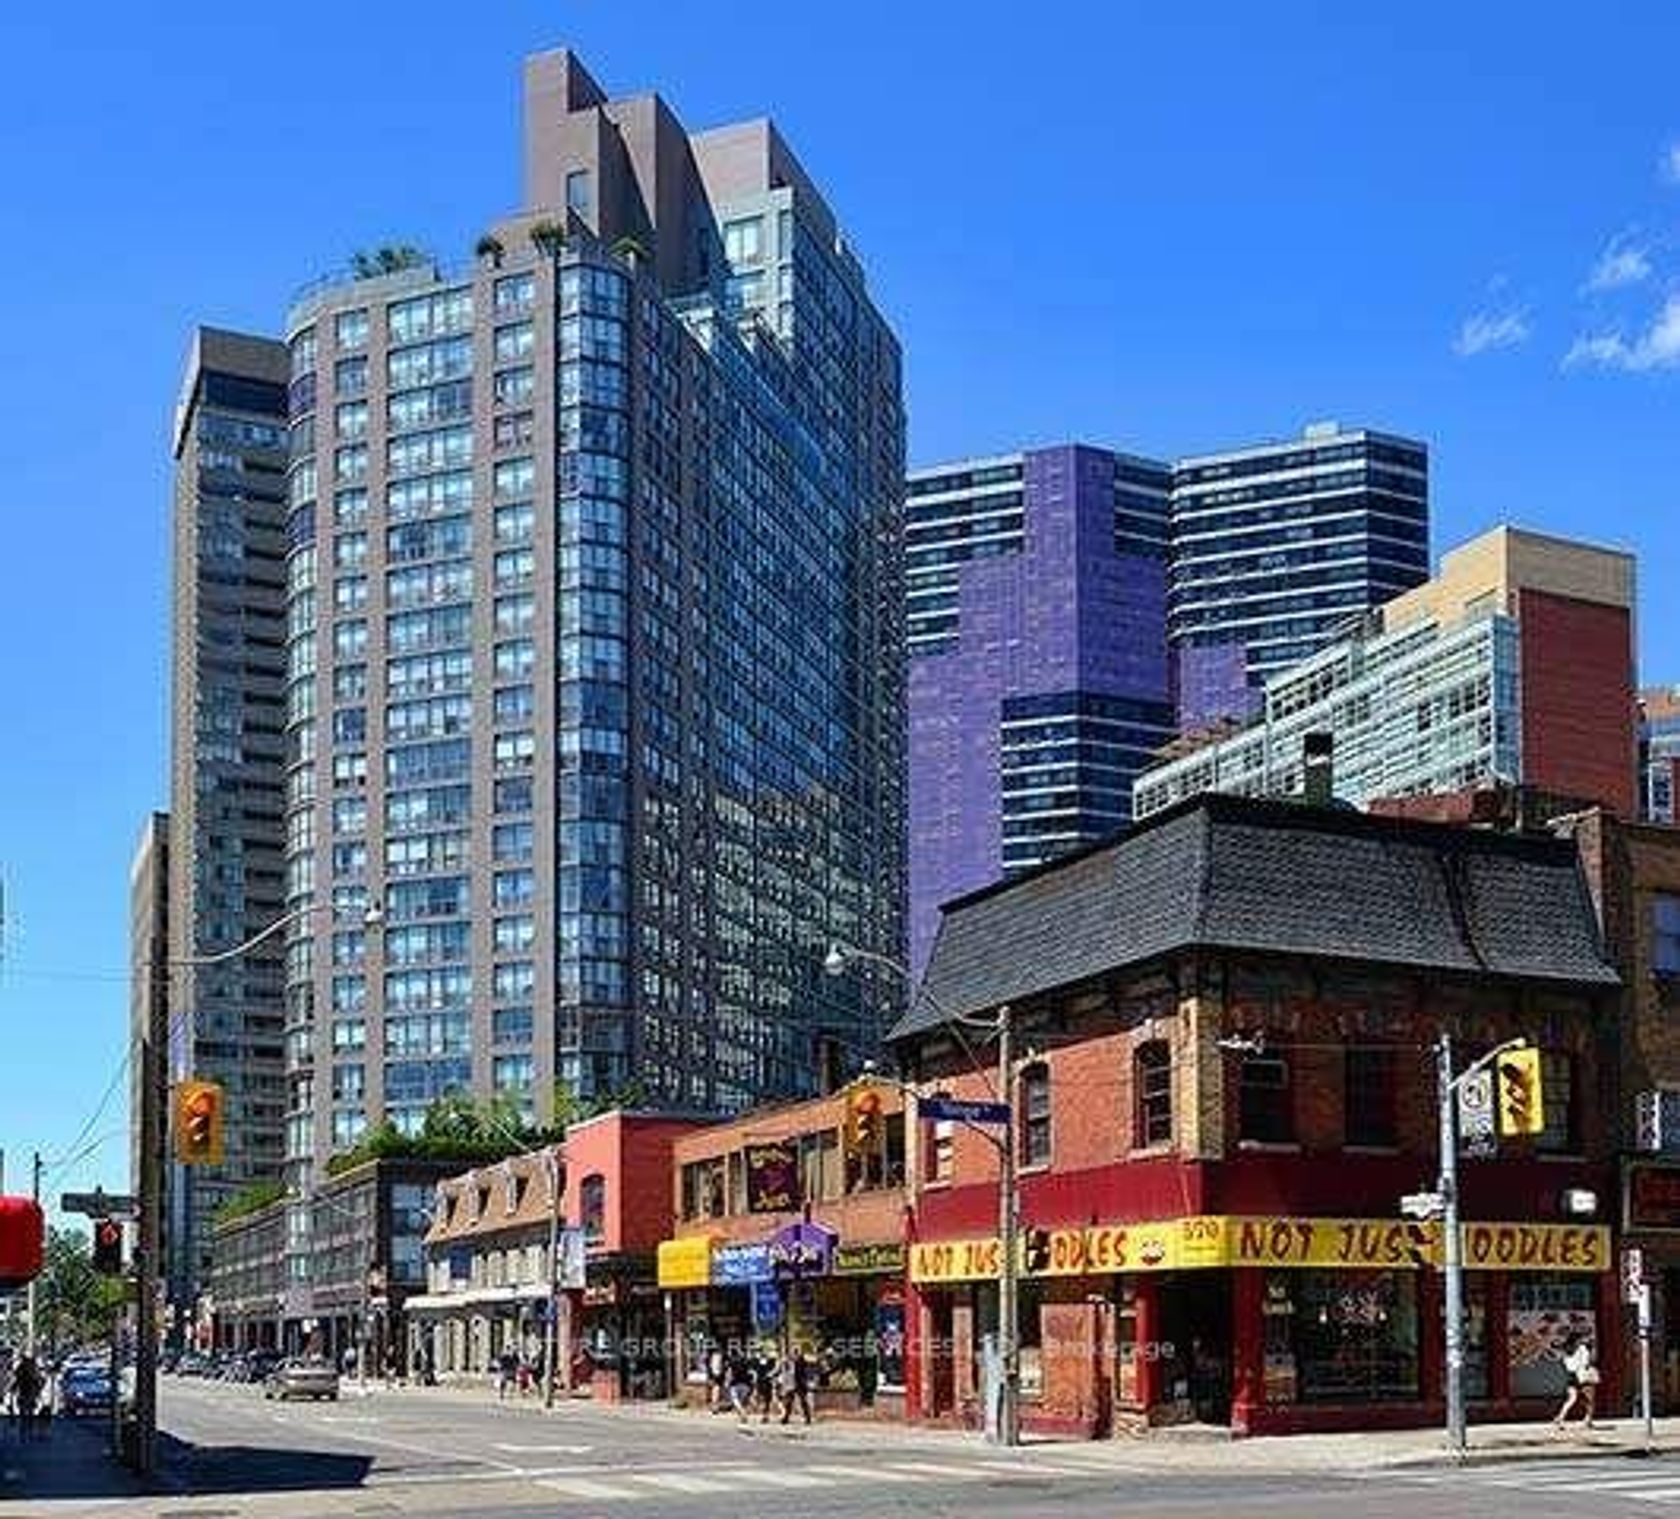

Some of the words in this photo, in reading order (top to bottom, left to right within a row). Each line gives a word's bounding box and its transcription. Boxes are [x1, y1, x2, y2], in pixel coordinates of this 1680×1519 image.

[918, 1246, 954, 1277] NOT
[964, 1241, 999, 1275] JUS
[1054, 1231, 1128, 1271] ODLES
[1240, 1221, 1314, 1260] NOT
[1339, 1222, 1402, 1263] JUS
[1465, 1226, 1597, 1265] OODLES
